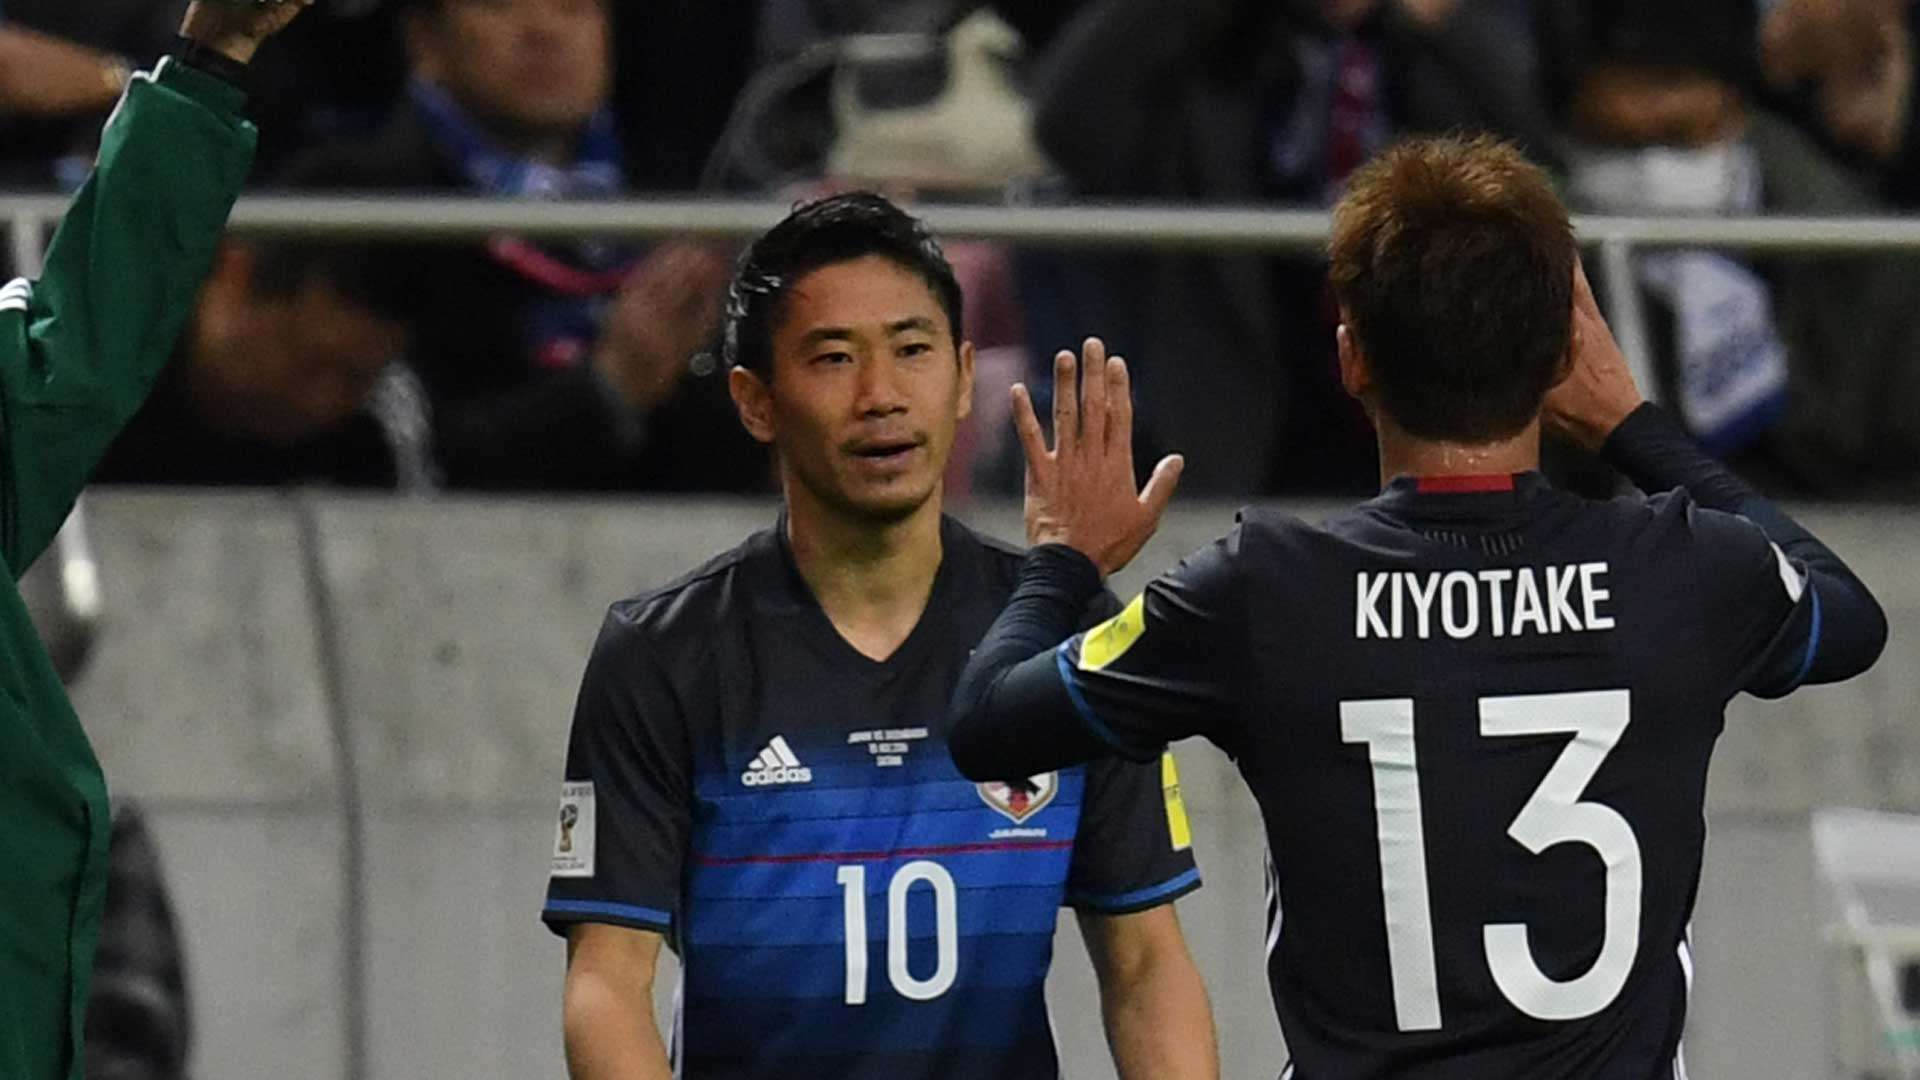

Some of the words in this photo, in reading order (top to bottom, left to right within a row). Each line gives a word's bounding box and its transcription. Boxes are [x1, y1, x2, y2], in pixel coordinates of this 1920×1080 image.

[1356, 562, 1615, 639] KIYOTAKE
[741, 766, 813, 787] adidas
[1339, 689, 1642, 1031] 13
[836, 860, 958, 1004] 10
